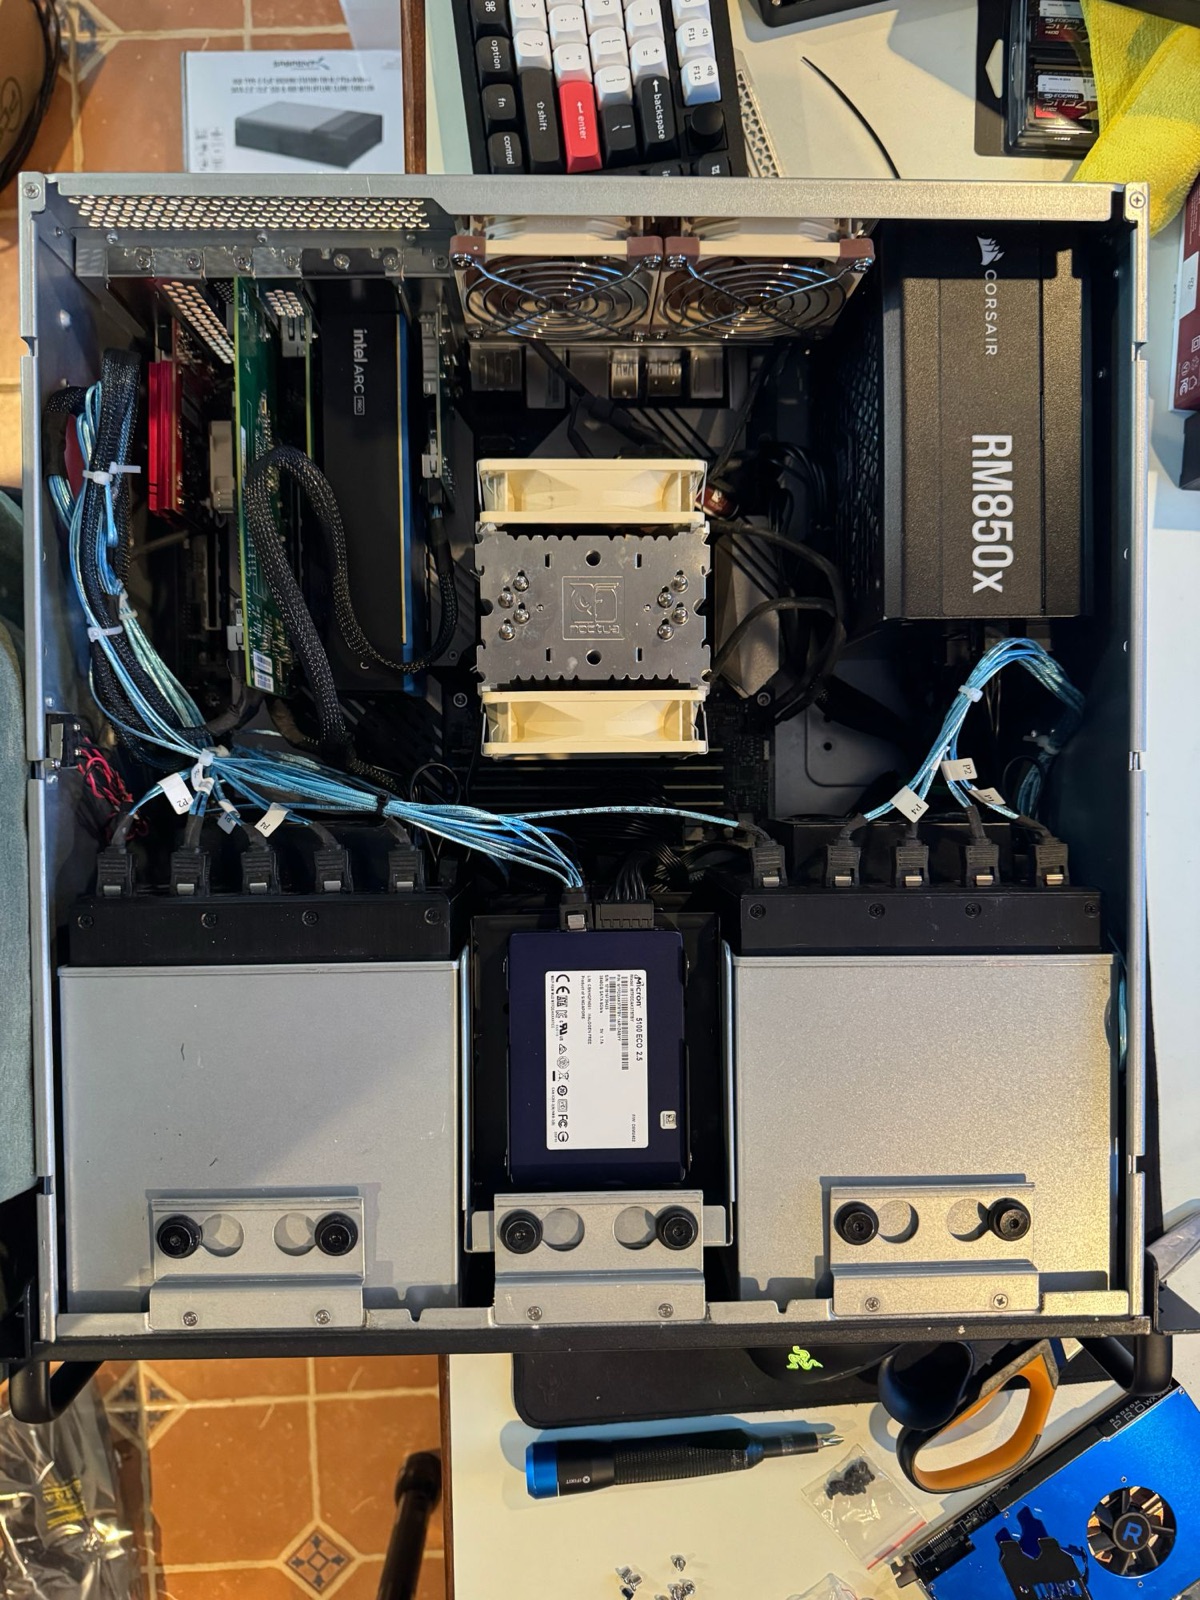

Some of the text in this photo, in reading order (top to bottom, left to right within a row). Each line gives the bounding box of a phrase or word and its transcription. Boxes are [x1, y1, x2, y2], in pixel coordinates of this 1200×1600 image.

[490, 40, 500, 69] option
[498, 98, 506, 108] fn
[537, 110, 547, 132] shift
[577, 114, 587, 140] enter
[653, 94, 665, 140] backspace
[503, 135, 515, 165] control
[984, 269, 998, 356] CORSAIR
[354, 328, 368, 362] intel
[354, 365, 364, 394] ARC
[971, 434, 1013, 594] RM850x
[962, 764, 972, 775] P2
[177, 798, 189, 808] P2
[911, 803, 922, 815] P4
[634, 974, 644, 1006] Micron
[1109, 1400, 1140, 1422] RADEON
[1113, 1404, 1145, 1428] PRO
